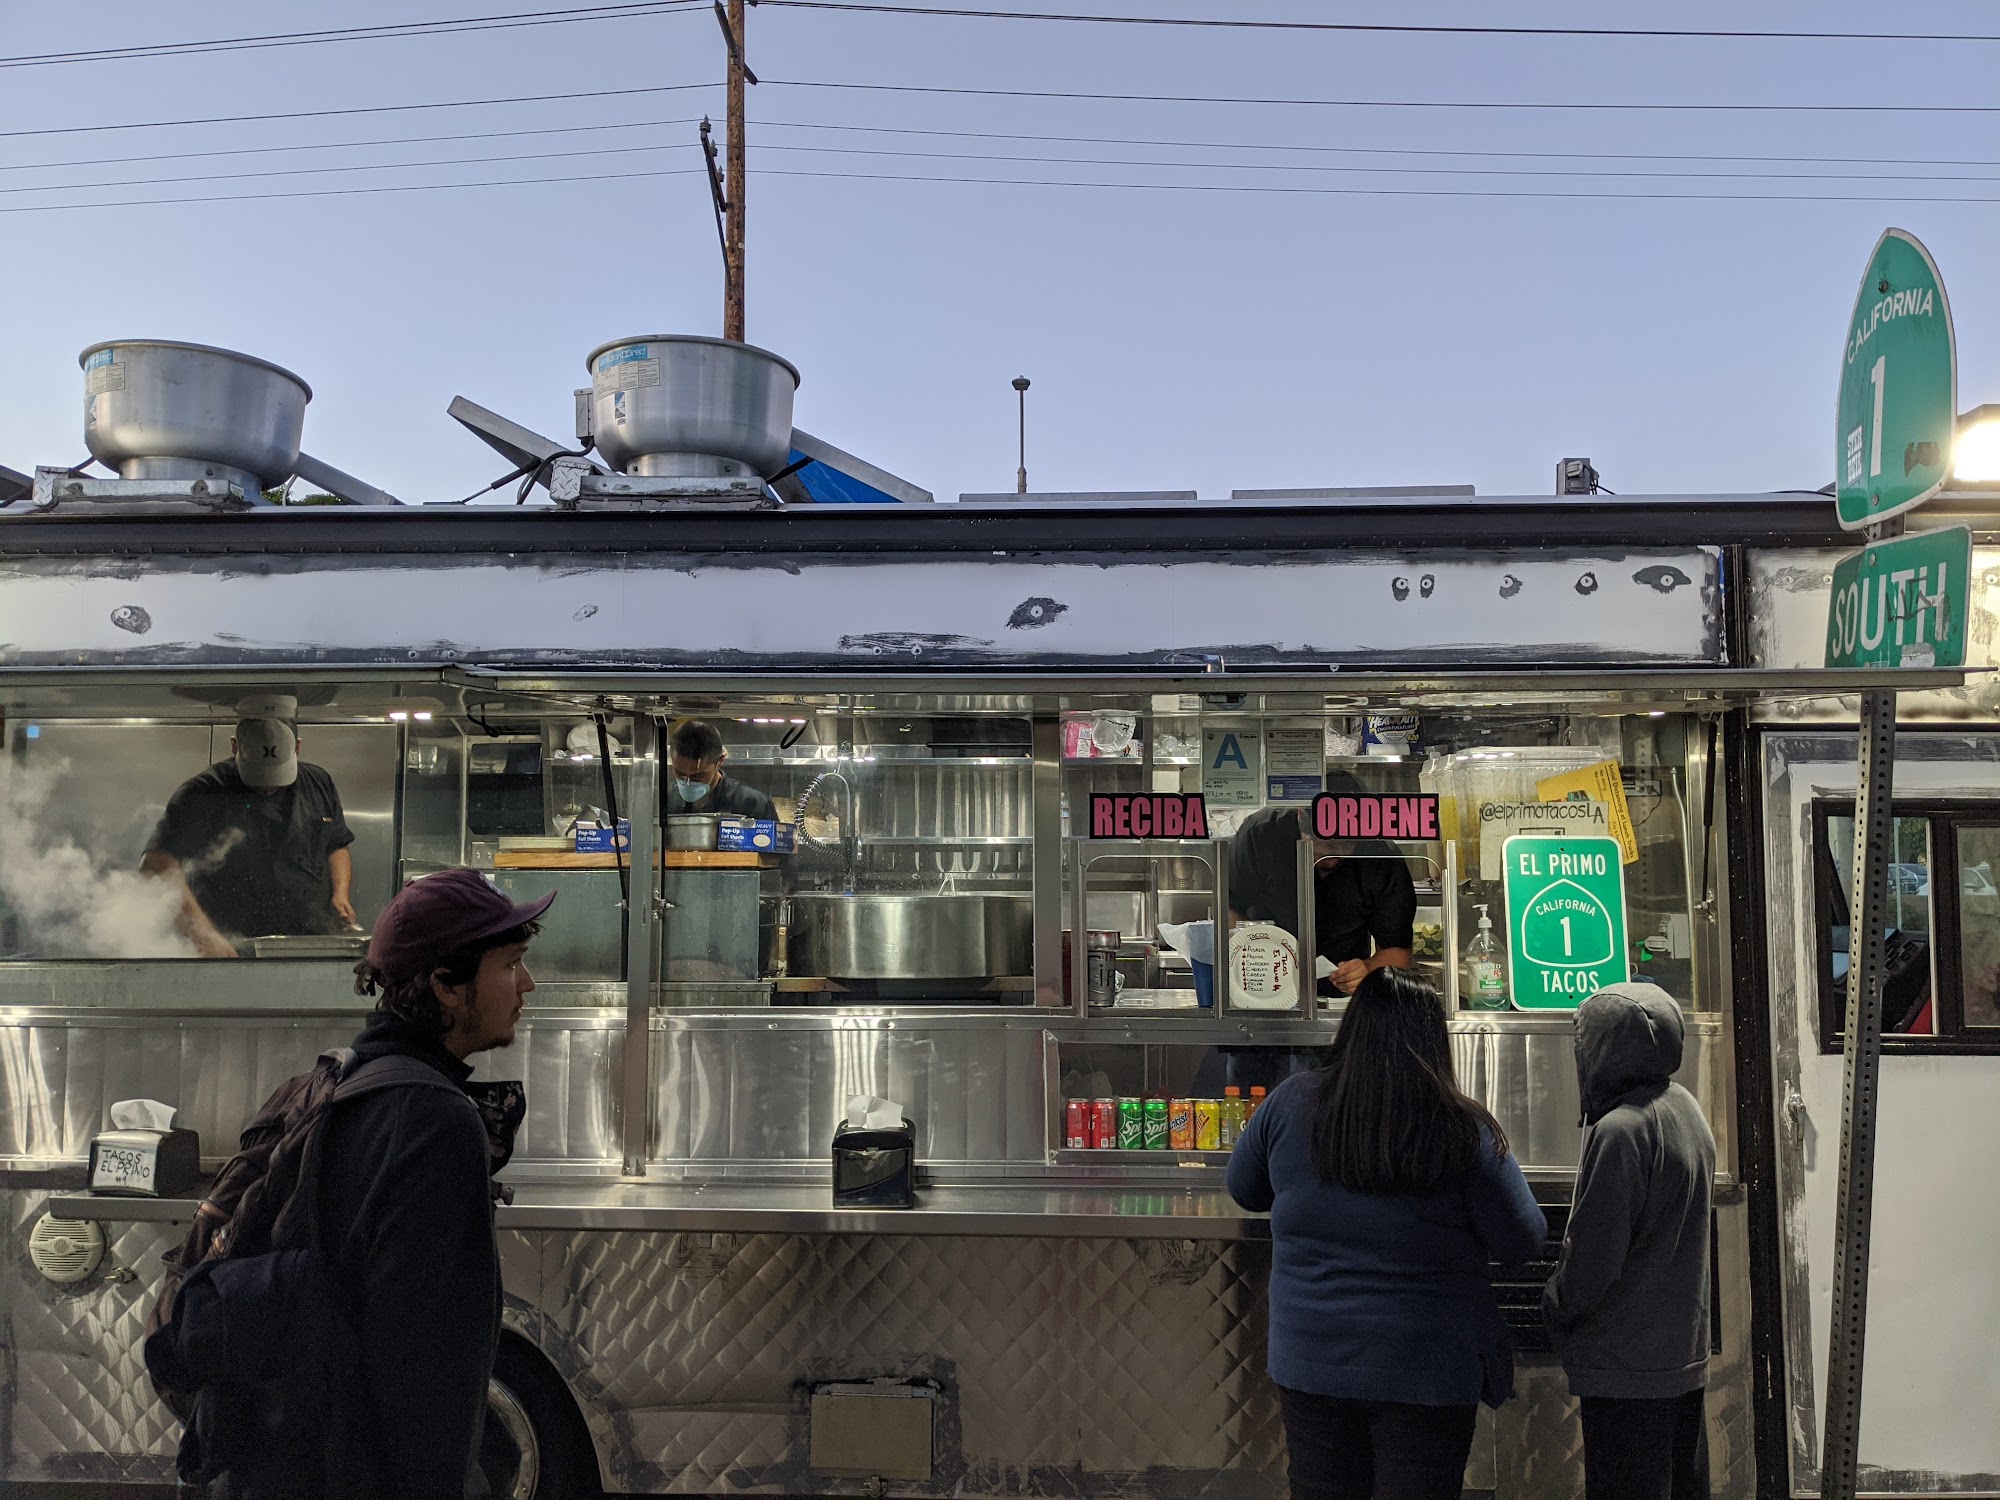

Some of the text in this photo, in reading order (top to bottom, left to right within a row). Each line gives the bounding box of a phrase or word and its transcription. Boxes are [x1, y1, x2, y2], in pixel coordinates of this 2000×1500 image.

[1847, 288, 1933, 364] CALIFORNIA
[1869, 355, 1886, 477] 1
[1832, 562, 1947, 659] SOUTH
[1213, 734, 1248, 769] A
[1094, 797, 1206, 836] RECIBA
[1316, 796, 1437, 837] ORDENE
[1480, 801, 1605, 827] @elprimotacosLA
[1608, 763, 1617, 782] Social
[1613, 783, 1624, 813] Distancing
[1622, 820, 1630, 839] Lunch
[1626, 838, 1634, 858] Trucks
[1520, 853, 1607, 876] EL PRIMO
[1535, 899, 1596, 917] CALIFORNIA
[1559, 916, 1572, 957] 1
[1540, 970, 1599, 993] TACOS
[101, 1149, 142, 1165] TACOS
